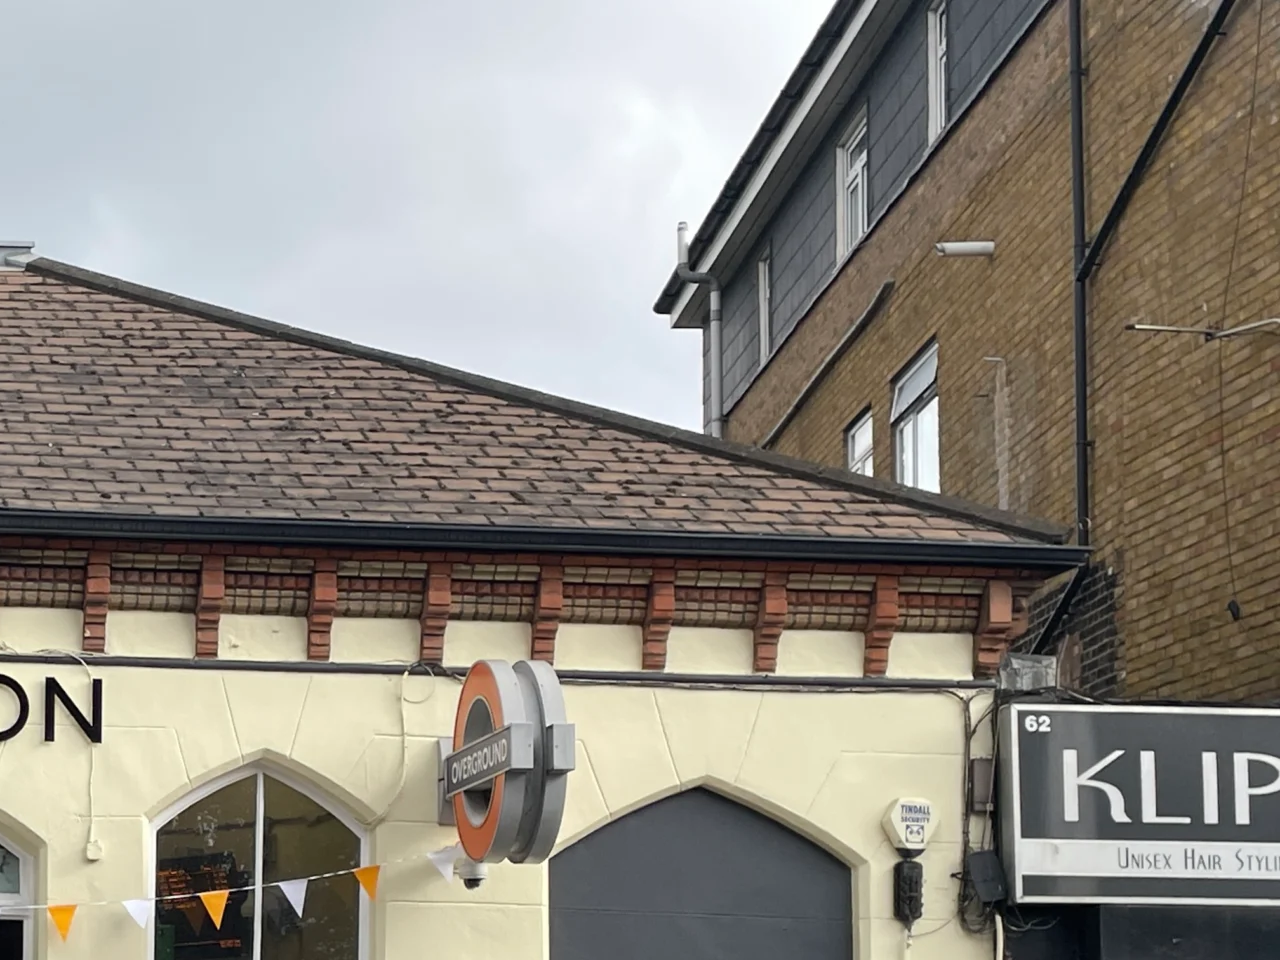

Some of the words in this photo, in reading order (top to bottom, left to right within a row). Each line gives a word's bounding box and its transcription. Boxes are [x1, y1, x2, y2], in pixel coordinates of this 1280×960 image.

[1024, 715, 1052, 732] 62
[451, 738, 508, 784] OVERGROUND
[1062, 748, 1280, 825] KLIP
[900, 804, 931, 816] TINDALL
[900, 816, 931, 824] SECURITY
